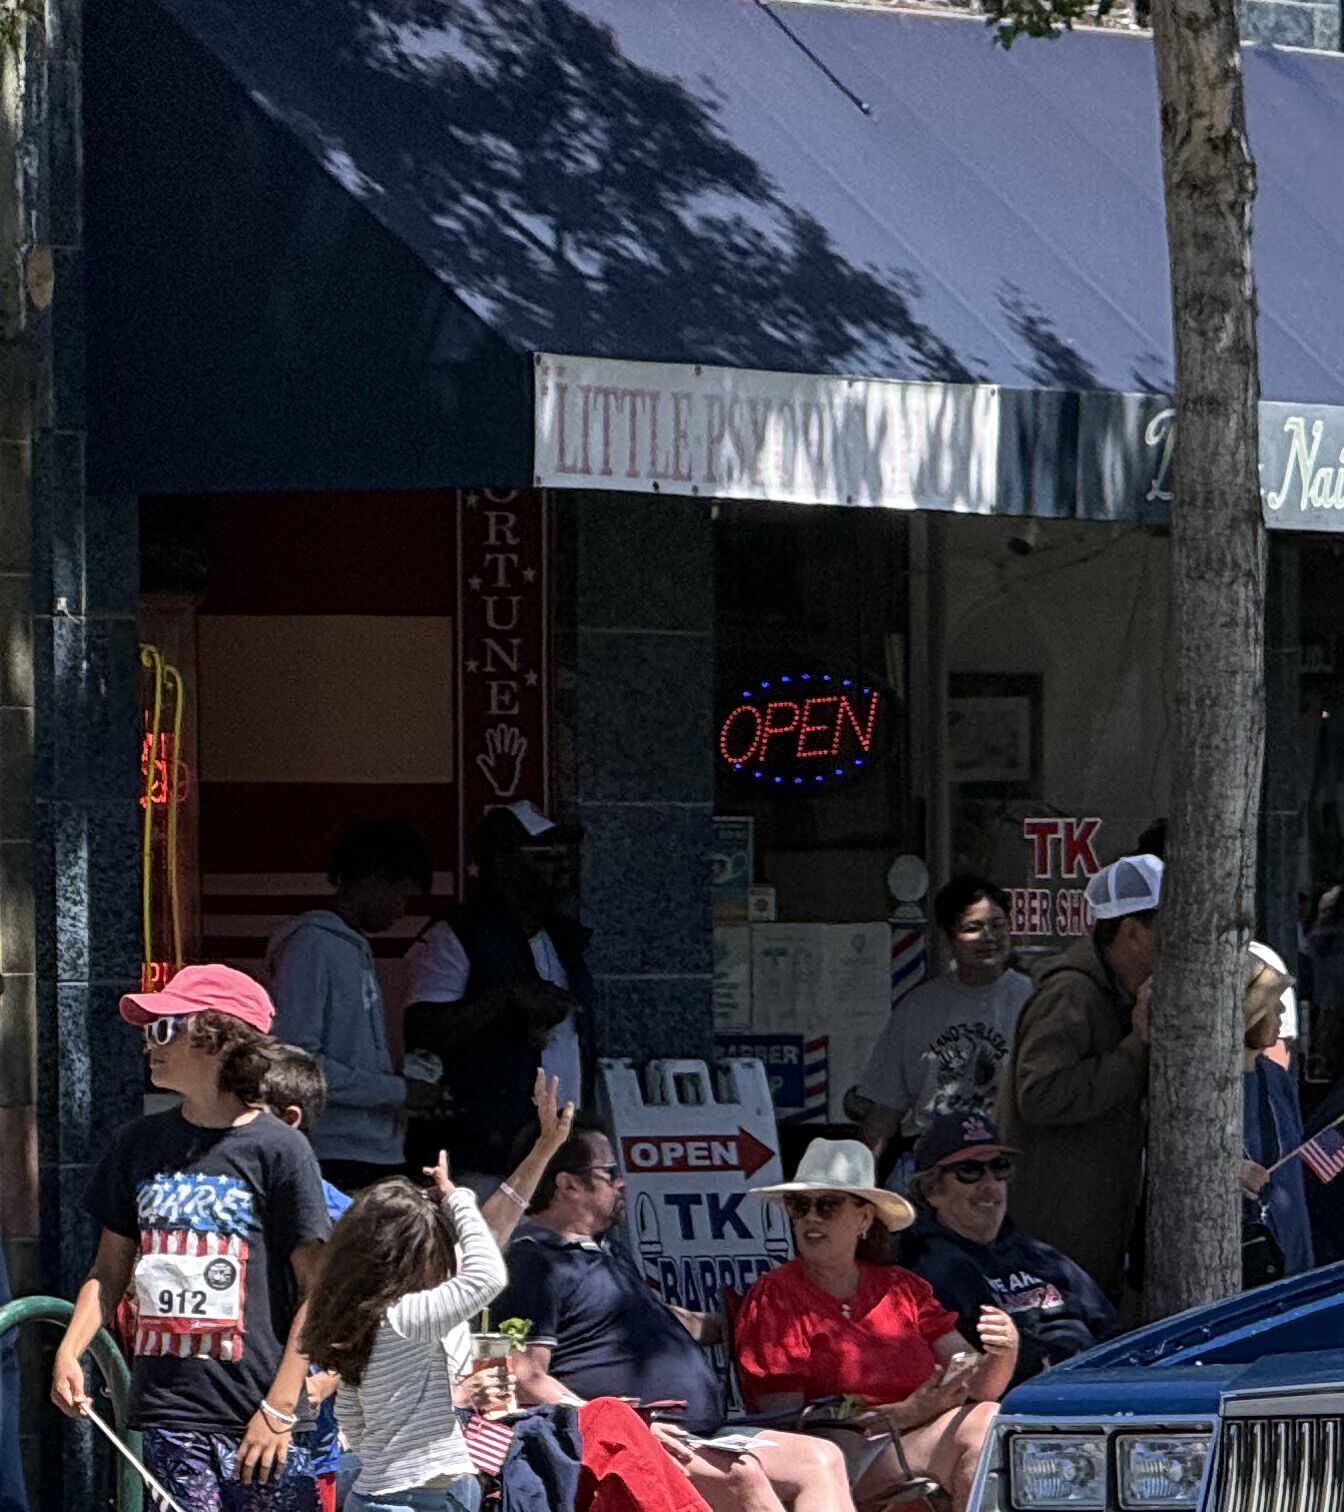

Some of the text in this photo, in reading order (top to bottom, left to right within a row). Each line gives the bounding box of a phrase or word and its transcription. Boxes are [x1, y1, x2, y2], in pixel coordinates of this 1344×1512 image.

[556, 383, 693, 482] LITTLE
[720, 691, 879, 763] OPEN
[1023, 818, 1102, 879] TK
[630, 1141, 739, 1168] OPEN
[663, 1193, 754, 1241] TK
[158, 1289, 208, 1315] 912
